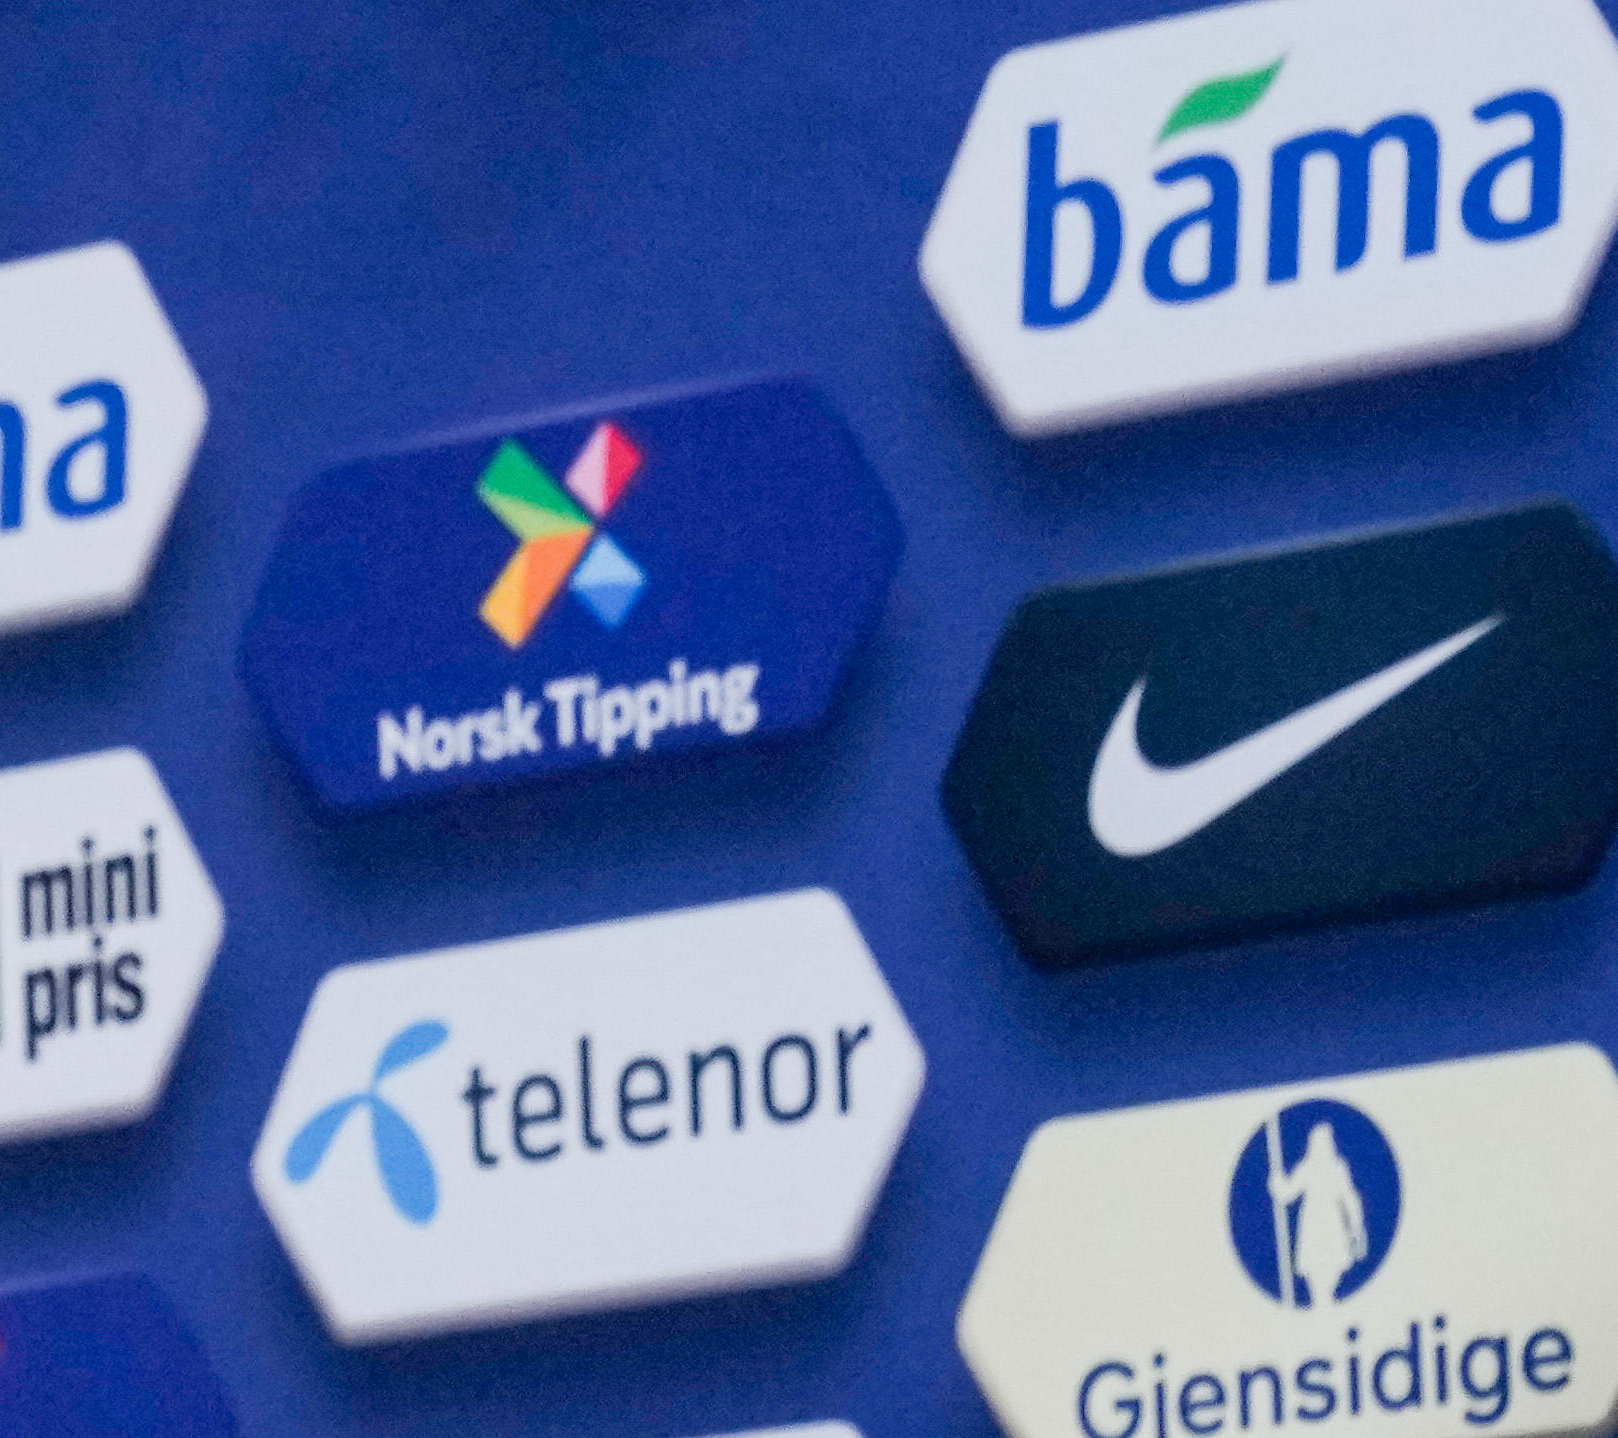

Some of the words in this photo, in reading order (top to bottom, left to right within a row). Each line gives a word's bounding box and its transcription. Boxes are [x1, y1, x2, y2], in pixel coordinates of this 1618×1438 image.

[1020, 88, 1564, 332] bama
[378, 687, 540, 780] Norsk
[543, 659, 760, 757] Tipping
[19, 825, 161, 940] mini
[24, 937, 147, 1064] pris
[462, 1023, 874, 1170] telenor
